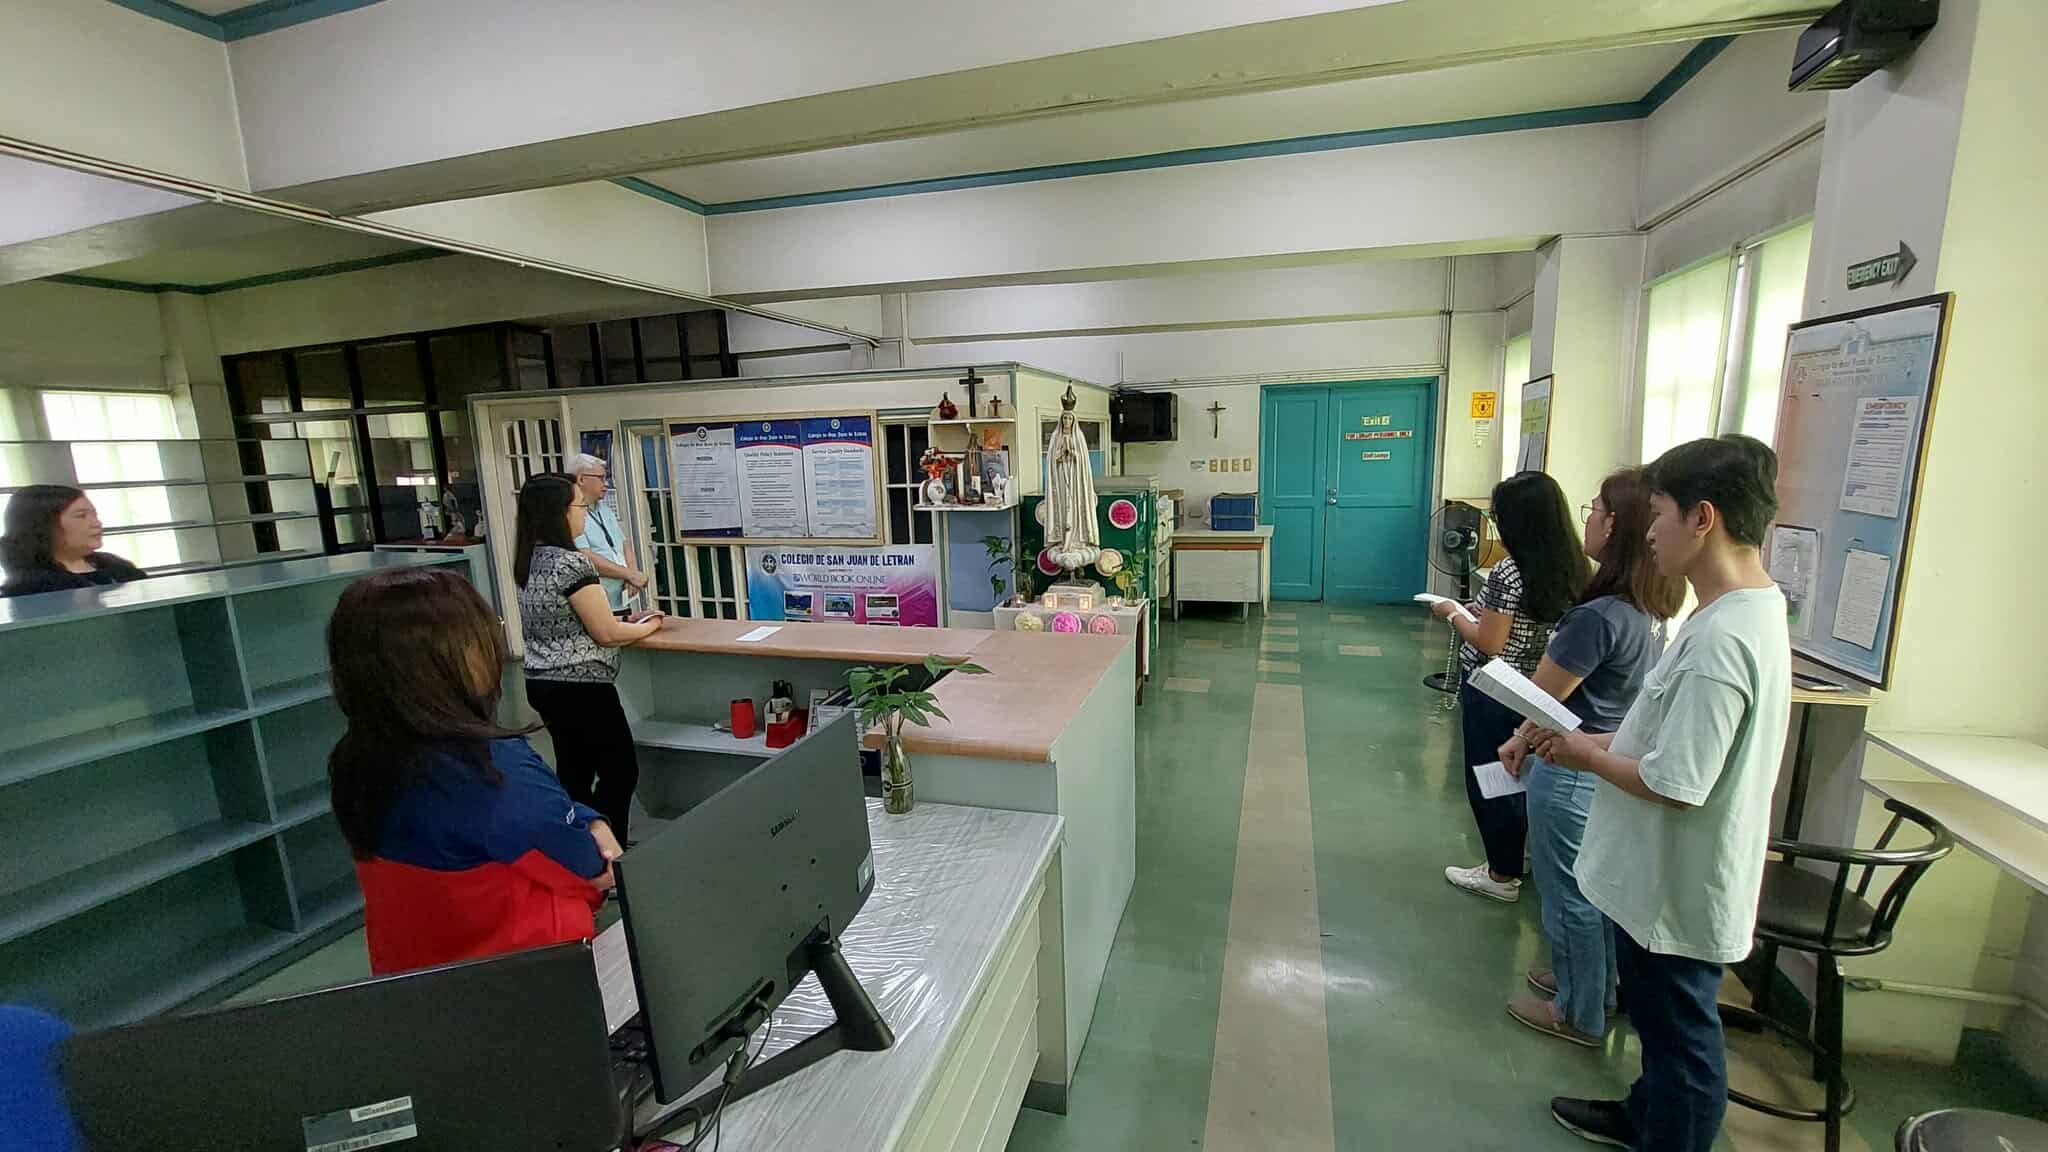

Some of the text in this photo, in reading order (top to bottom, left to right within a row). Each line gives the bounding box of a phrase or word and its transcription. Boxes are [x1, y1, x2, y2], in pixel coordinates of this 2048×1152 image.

[1847, 256, 1900, 285] EMERGENCY EXIT
[1363, 415, 1380, 426] Exit
[780, 553, 915, 566] COLEGIO DE SAN JUAN DE LETRAN
[799, 574, 888, 585] WORLD BOOK ONLINE
